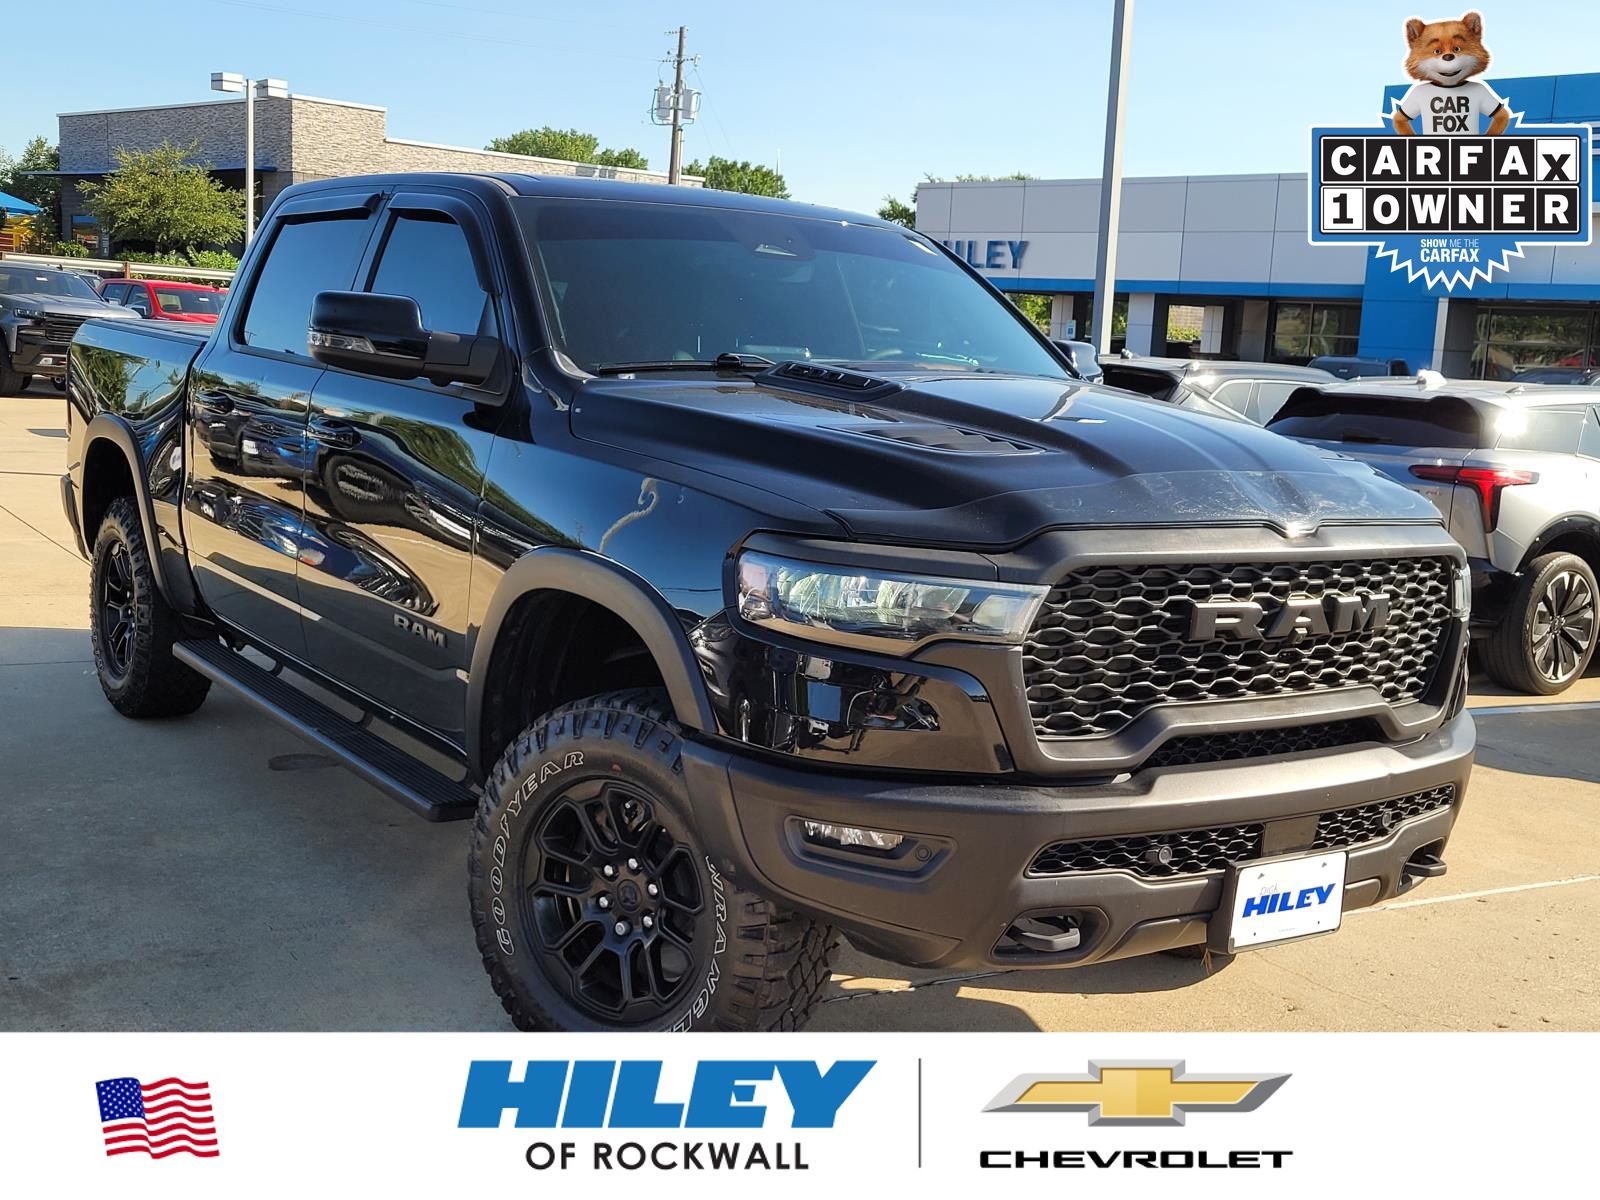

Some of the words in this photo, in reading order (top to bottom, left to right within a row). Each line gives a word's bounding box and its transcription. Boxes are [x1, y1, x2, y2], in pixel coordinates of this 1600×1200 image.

[943, 240, 1030, 269] ILEY
[393, 613, 448, 648] RAM
[1189, 594, 1391, 641] RAM
[490, 751, 584, 956] GOODYEAR
[1242, 883, 1336, 918] HILEY
